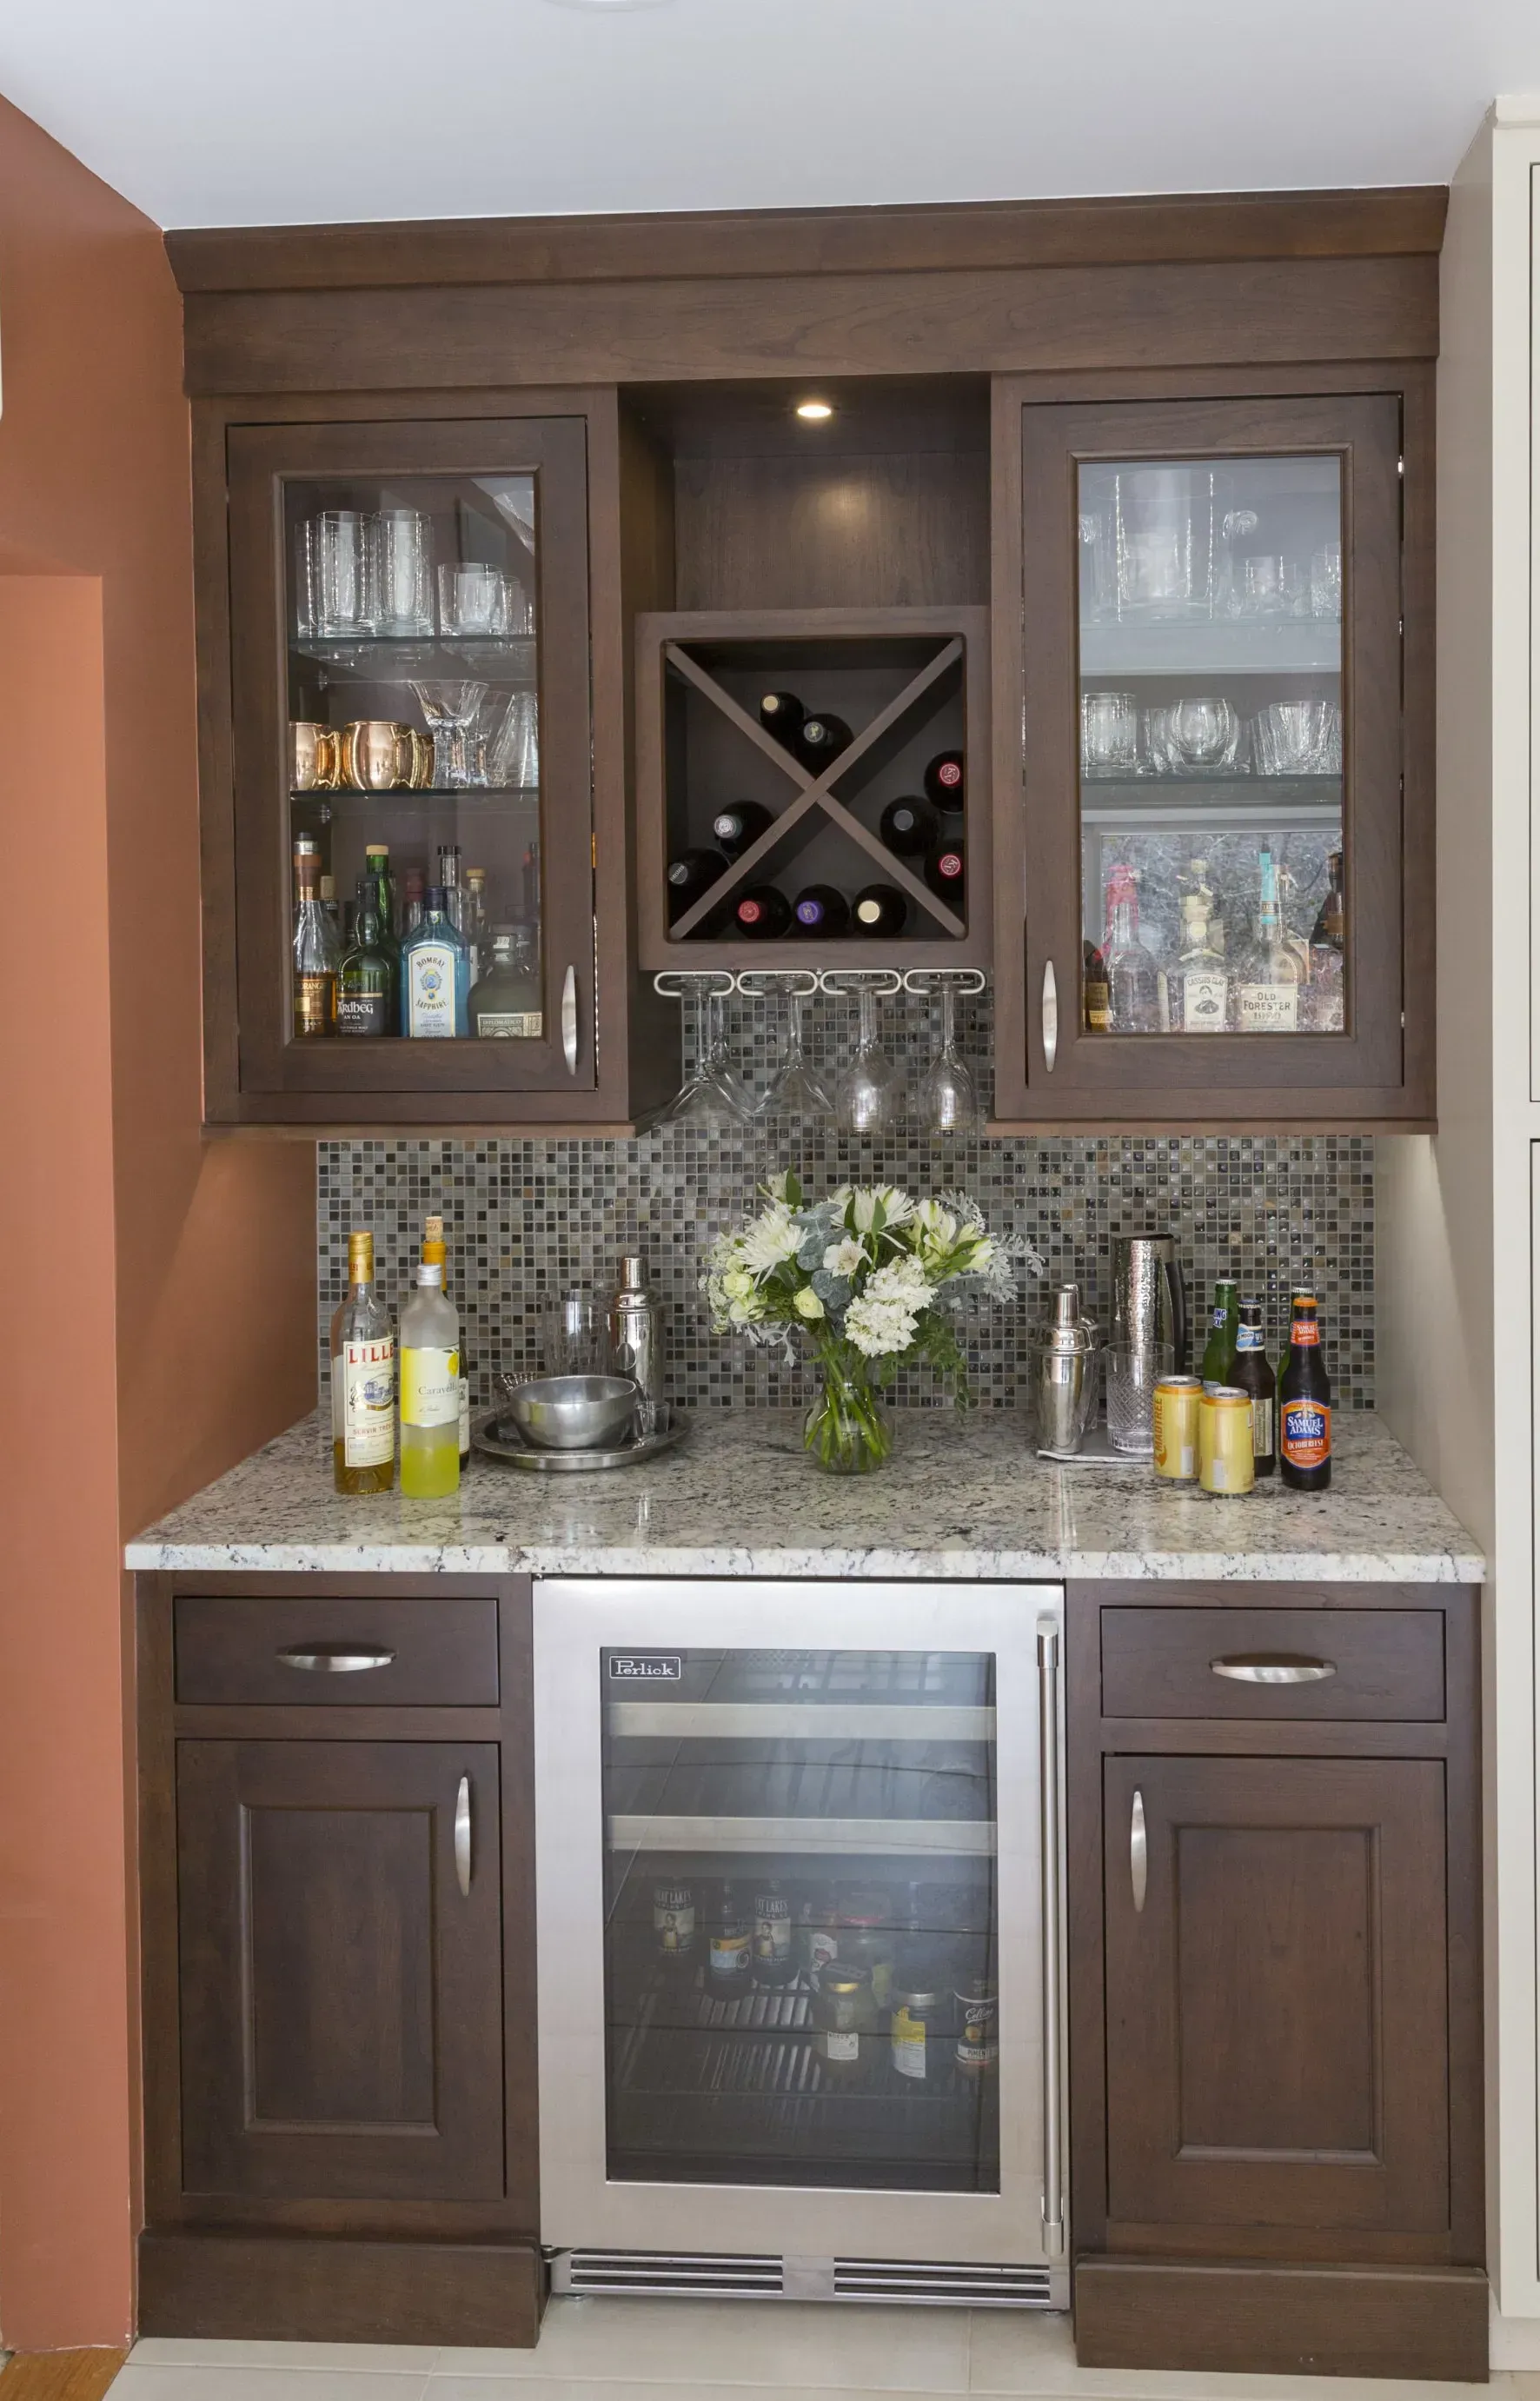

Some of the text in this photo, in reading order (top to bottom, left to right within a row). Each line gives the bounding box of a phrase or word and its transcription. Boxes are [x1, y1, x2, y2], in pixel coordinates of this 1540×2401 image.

[416, 957, 445, 969] BOMBAY
[1258, 992, 1276, 1001] OLD
[415, 998, 447, 1009] SAPPHIRE
[1244, 1001, 1291, 1010] FORESTER
[1153, 1398, 1163, 1451] MADTREE
[1287, 1415, 1323, 1427] SAMUEL
[1290, 1426, 1320, 1435] ADAMS
[615, 1660, 675, 1675] Perlick
